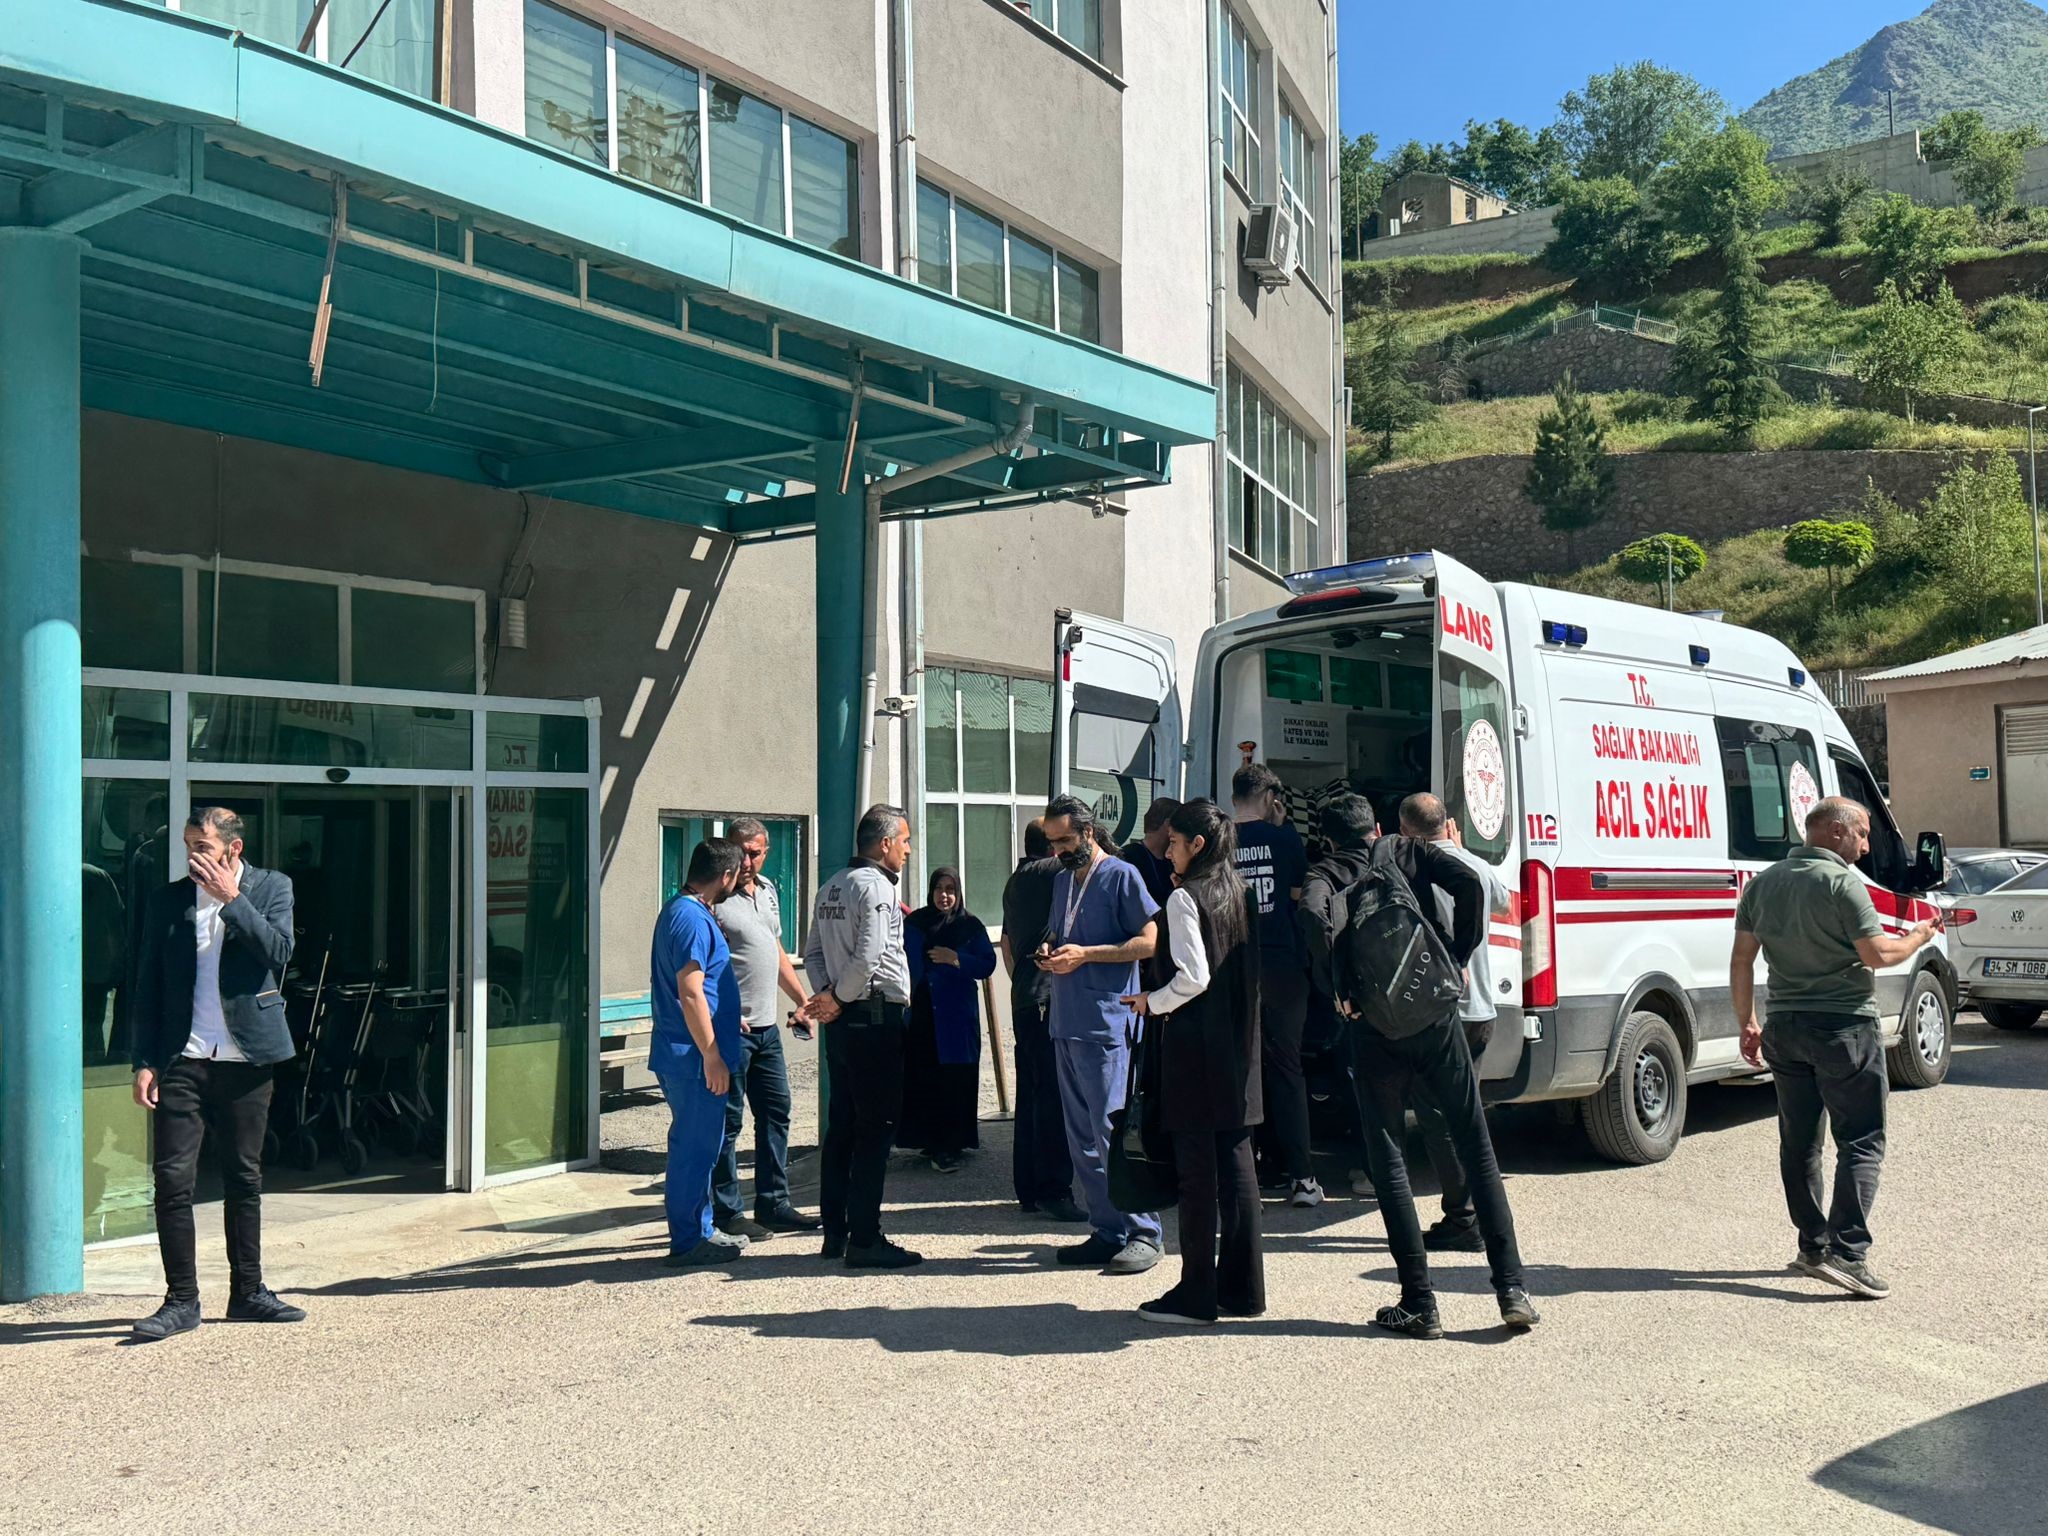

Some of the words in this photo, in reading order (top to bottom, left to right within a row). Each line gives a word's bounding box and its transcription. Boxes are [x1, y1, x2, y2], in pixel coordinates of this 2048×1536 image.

[1626, 672, 1655, 707] T.C.
[1592, 721, 1638, 760] SAĞLIK
[1638, 729, 1701, 766] BAKANLIĞI
[1643, 775, 1711, 839] SAĞLIK
[1527, 814, 1557, 840] 112
[1990, 960, 2001, 972] 34
[2005, 961, 2018, 973] SM
